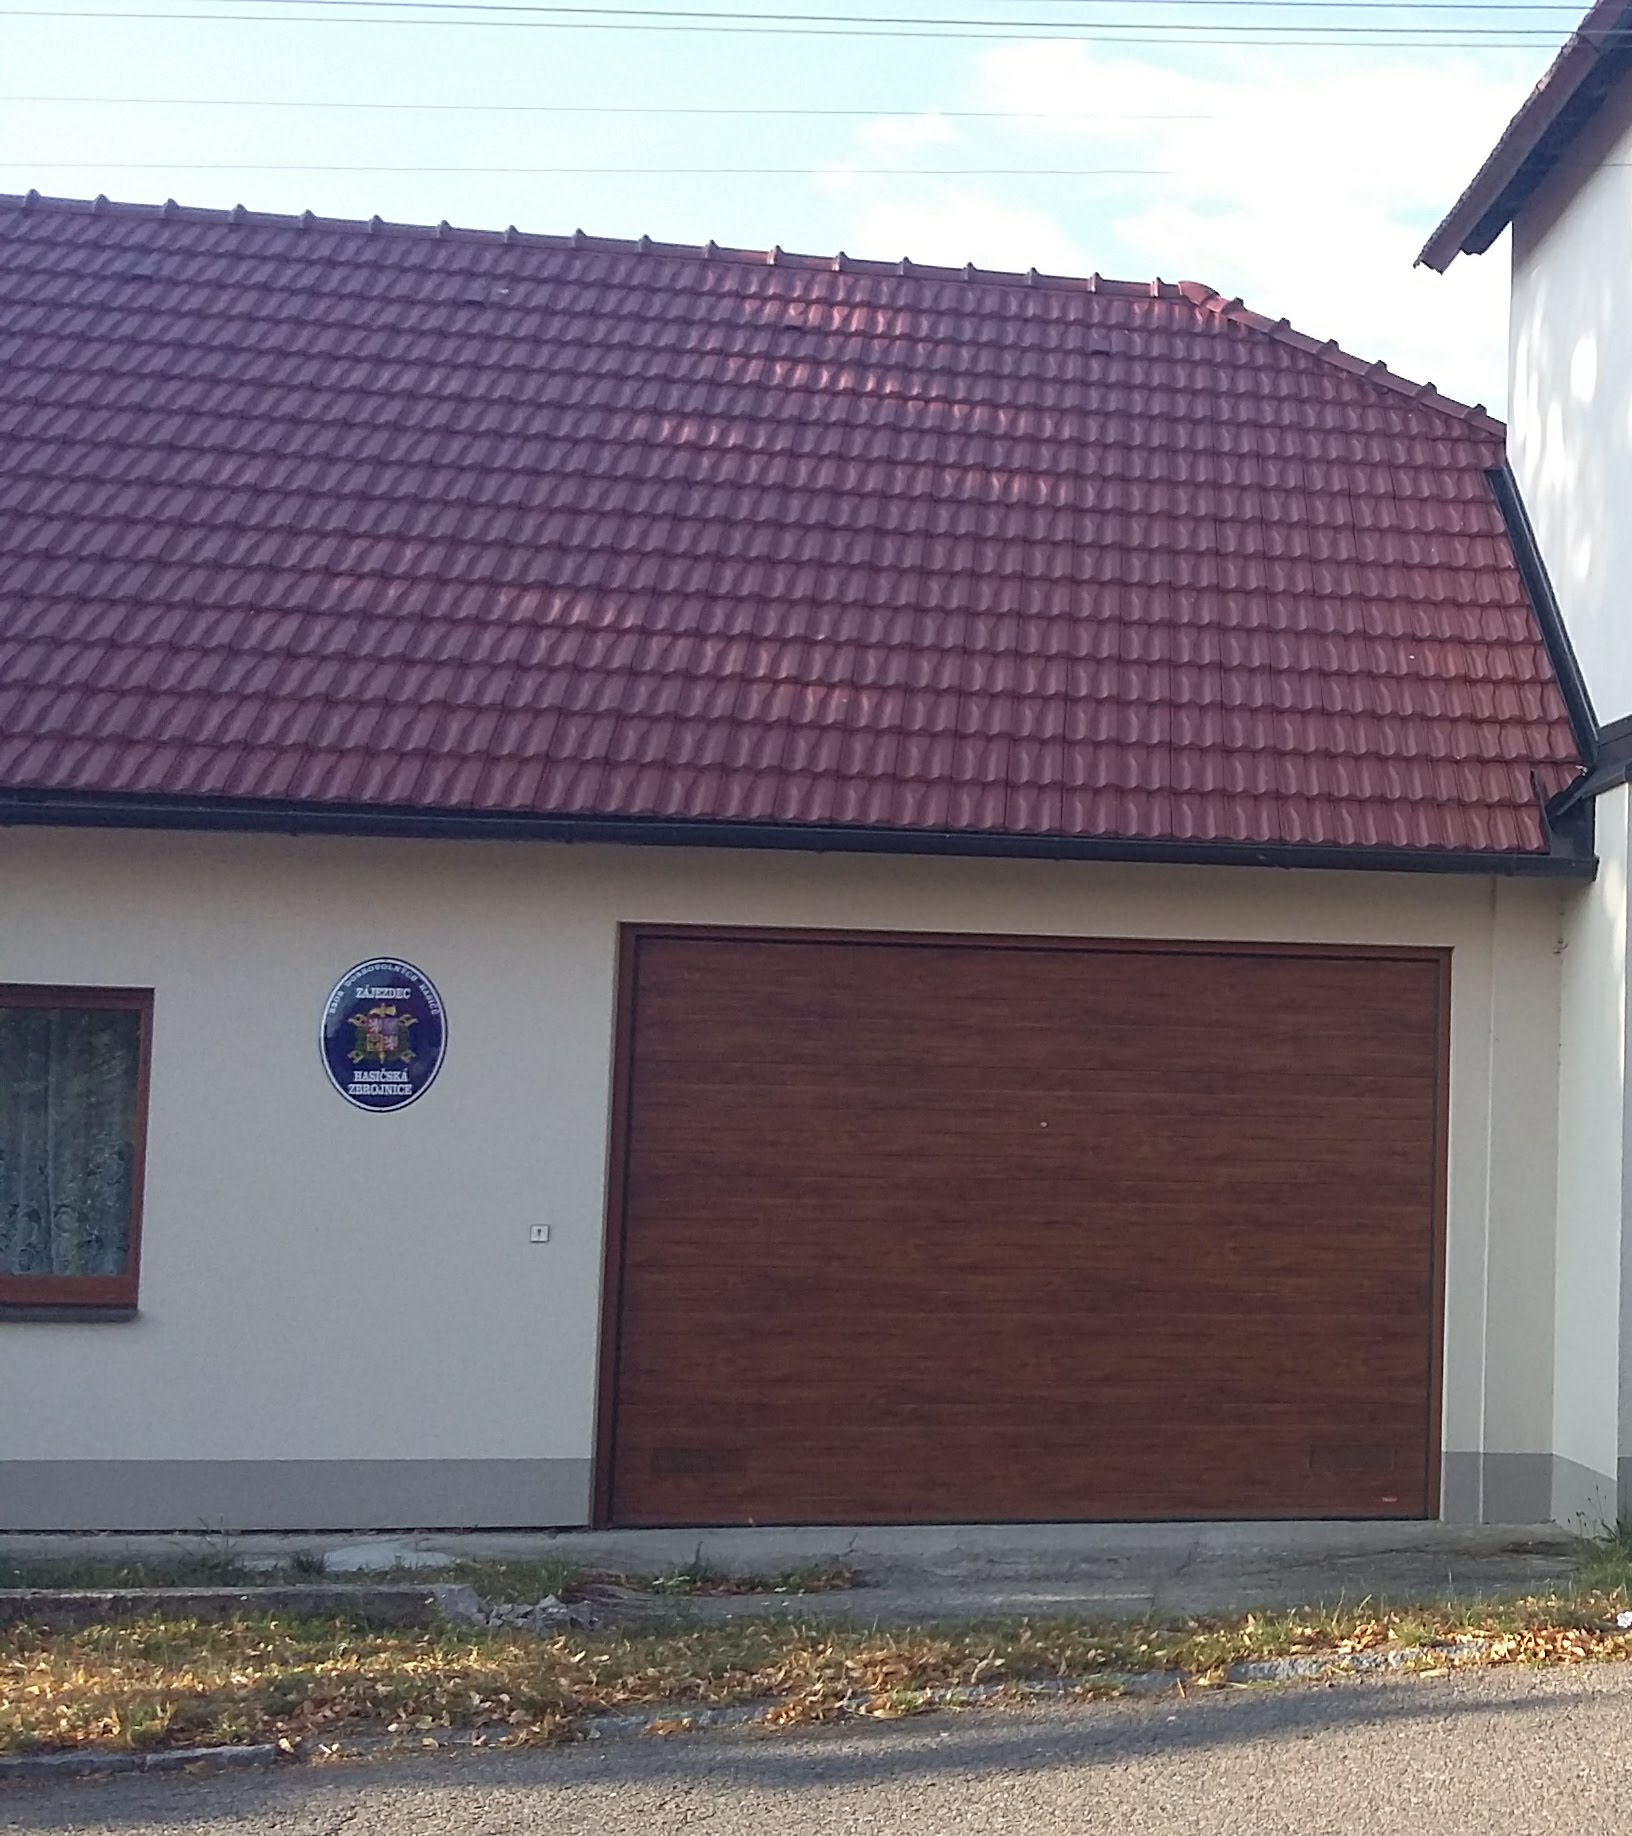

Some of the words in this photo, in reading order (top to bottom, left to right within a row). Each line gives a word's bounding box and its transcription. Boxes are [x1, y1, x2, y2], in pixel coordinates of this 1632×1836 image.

[355, 984, 411, 999] ZÁJEZDEC
[353, 1067, 409, 1082] HASIČSKÁ
[348, 1083, 412, 1095] ZBROJNICE
